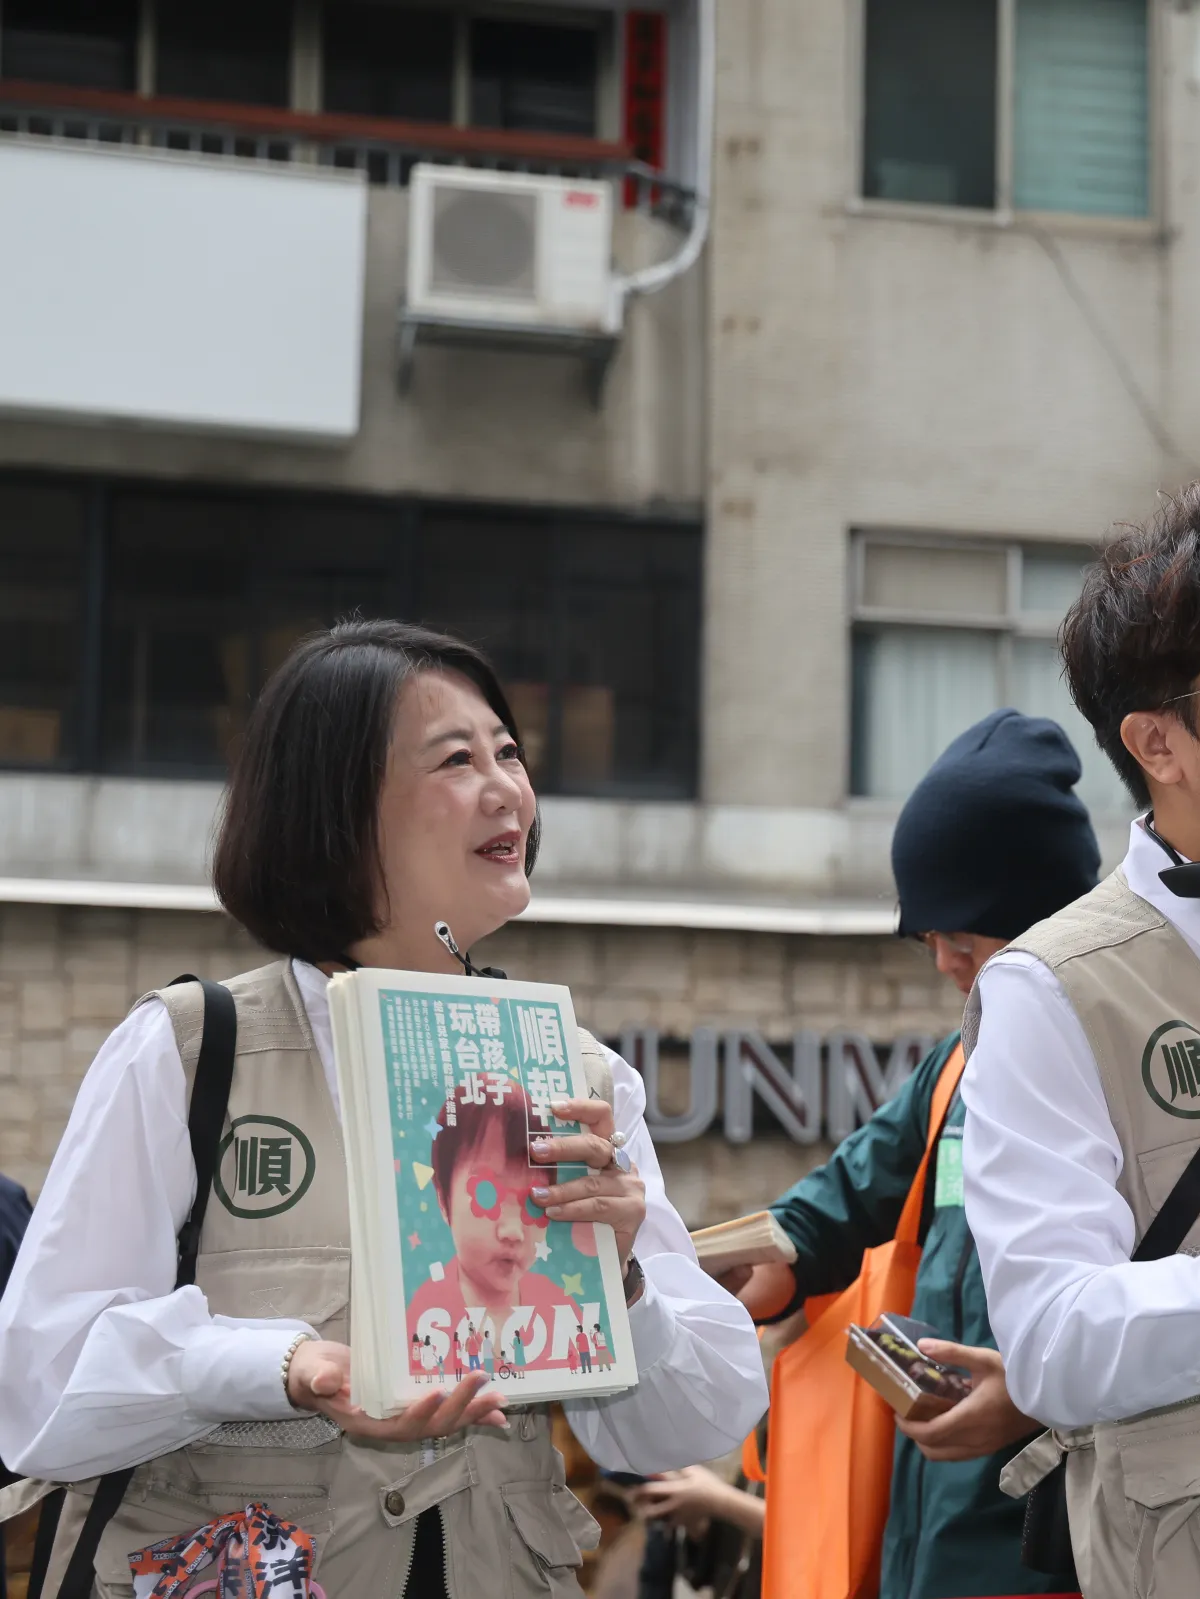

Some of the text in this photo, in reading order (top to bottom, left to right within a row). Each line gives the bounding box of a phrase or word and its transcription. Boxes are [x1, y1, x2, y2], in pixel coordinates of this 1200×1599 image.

[448, 1002, 487, 1105] 玩台北
[474, 1003, 512, 1106] 帶孩子
[232, 1136, 292, 1199] 順
[416, 1302, 602, 1370] SOON
